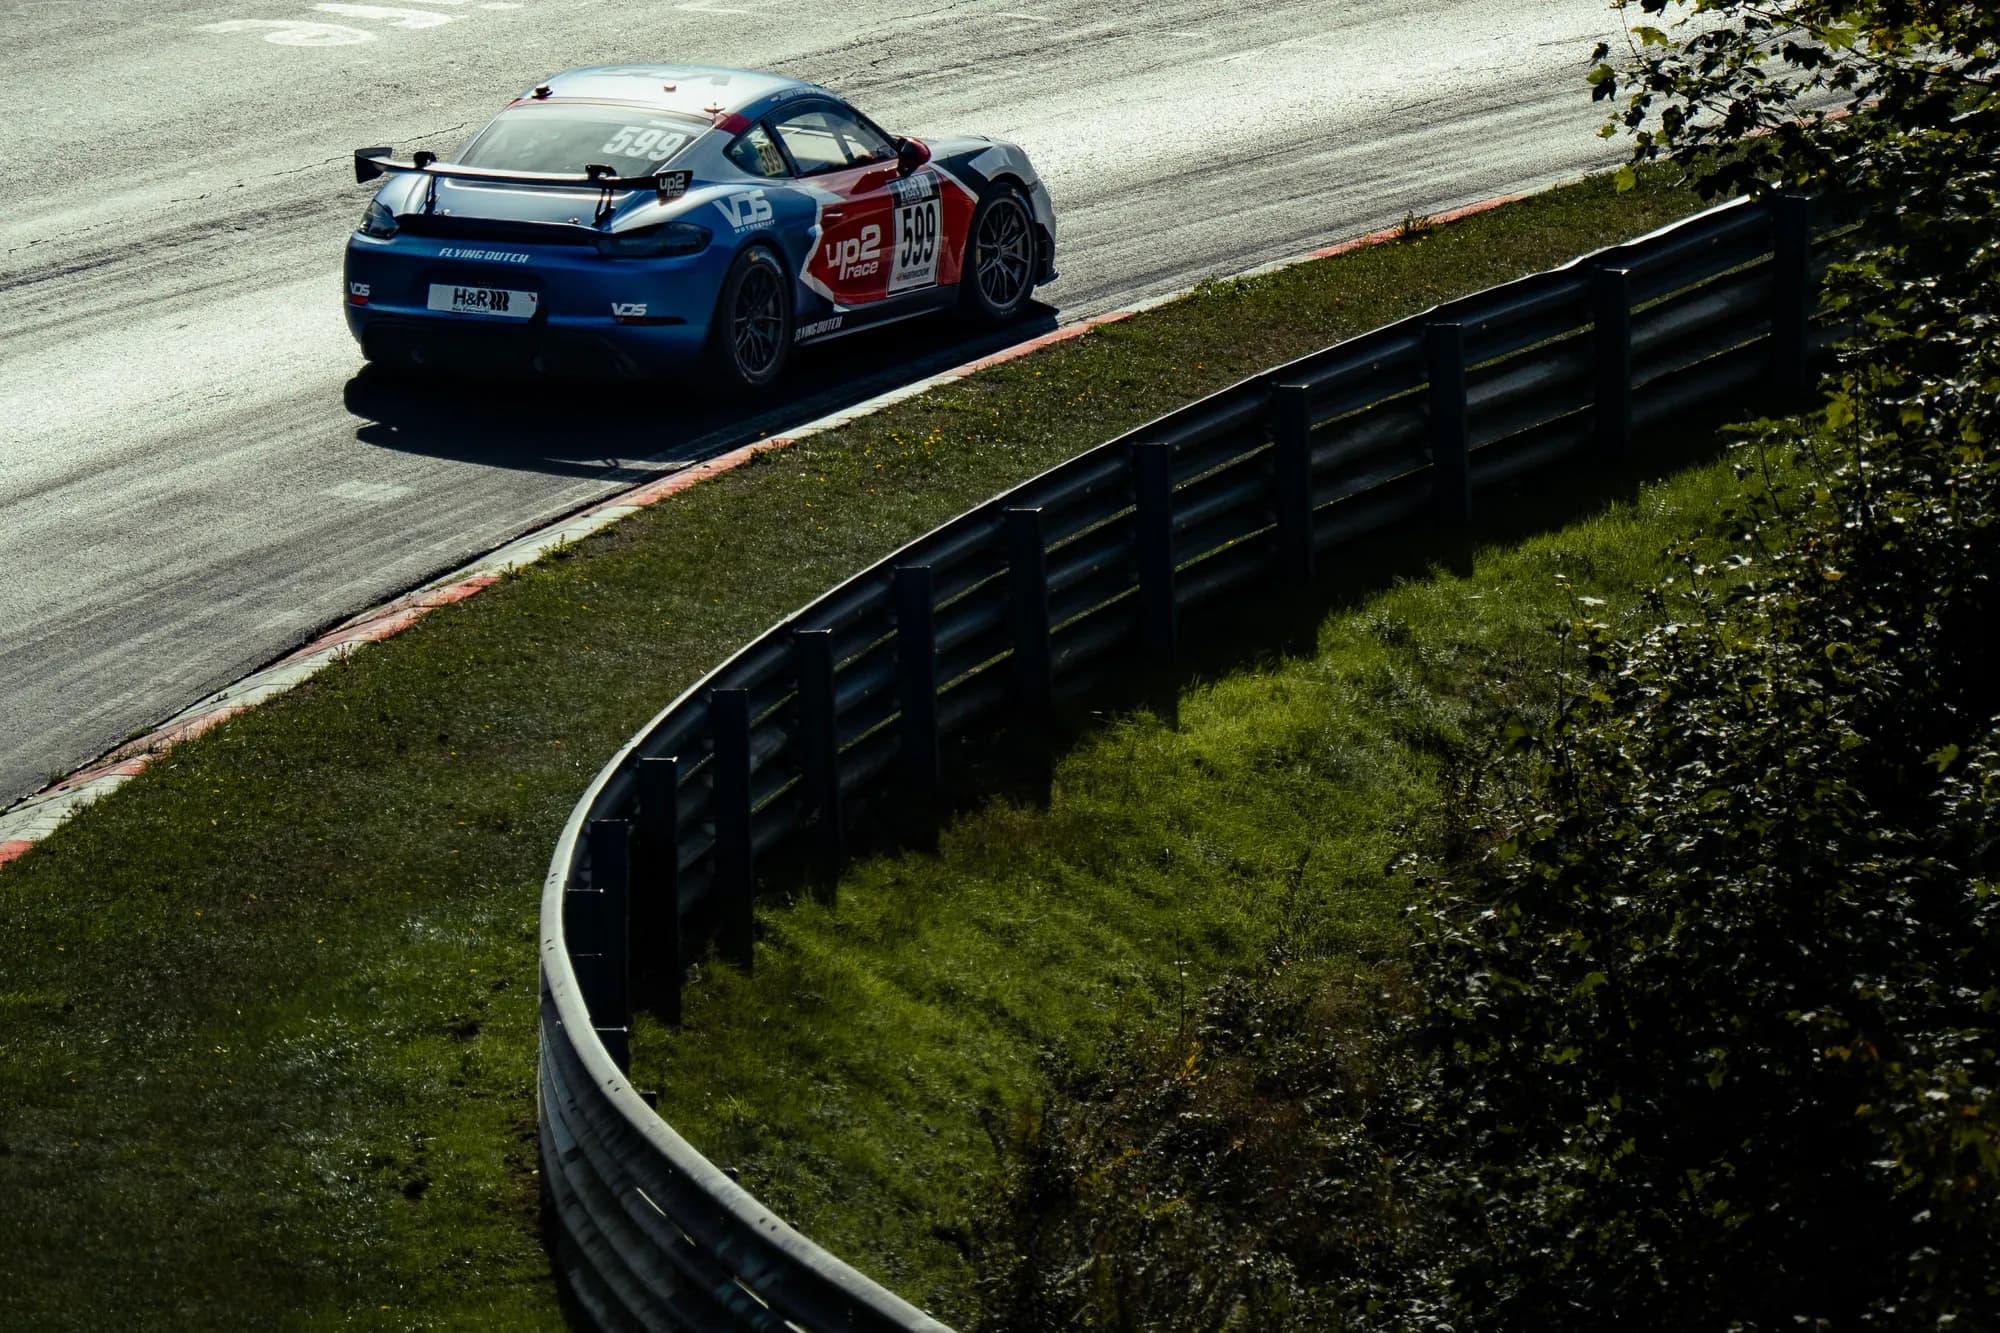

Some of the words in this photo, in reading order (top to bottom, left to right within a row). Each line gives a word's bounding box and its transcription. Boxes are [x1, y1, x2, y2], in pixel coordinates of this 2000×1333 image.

[602, 126, 688, 161] 599
[660, 172, 685, 197] up2
[712, 189, 772, 229] VDS
[901, 203, 936, 268] 599
[439, 247, 484, 259] FLYING
[484, 251, 530, 263] DUTCH
[825, 224, 881, 280] up2
[846, 261, 879, 279] race
[350, 281, 370, 297] VDS
[453, 287, 488, 307] H&R
[611, 302, 647, 316] VDS
